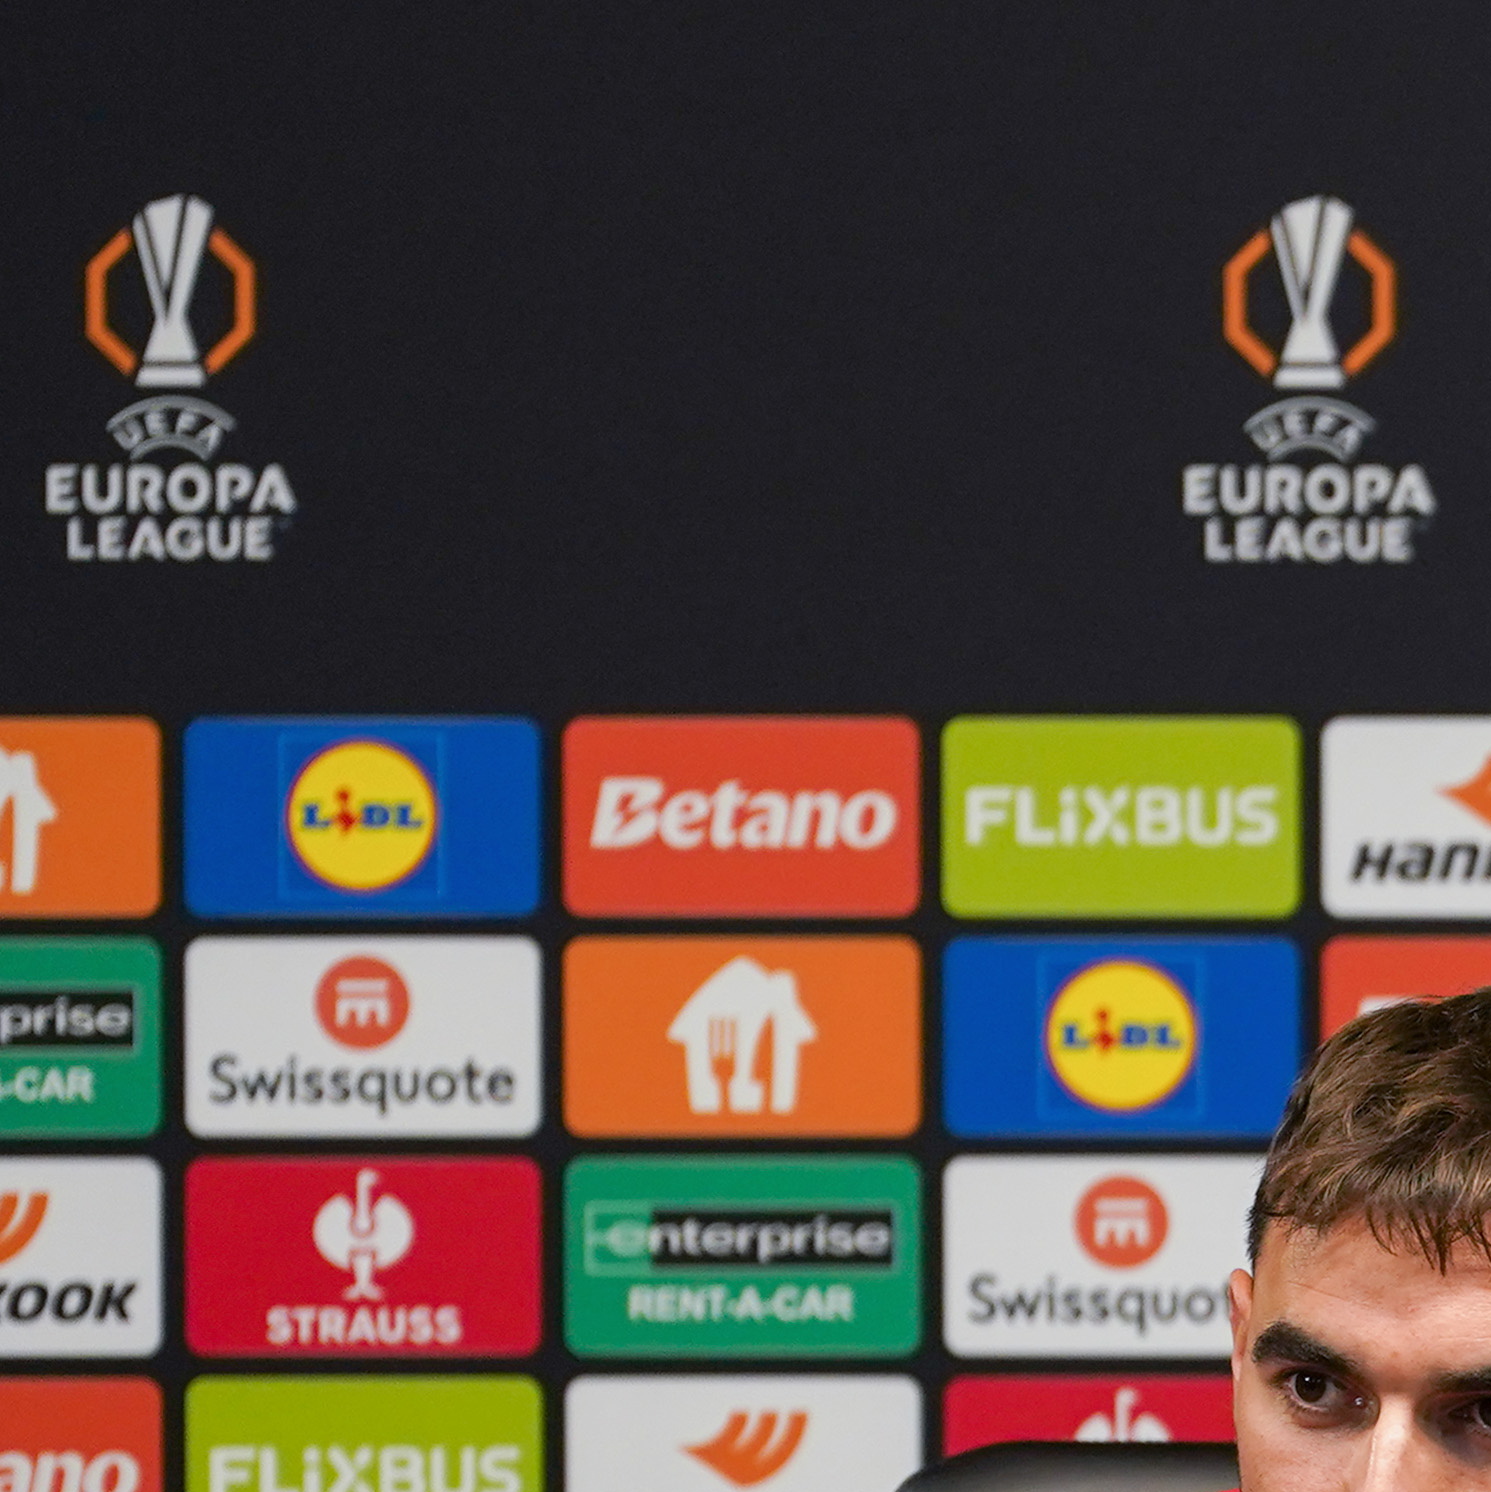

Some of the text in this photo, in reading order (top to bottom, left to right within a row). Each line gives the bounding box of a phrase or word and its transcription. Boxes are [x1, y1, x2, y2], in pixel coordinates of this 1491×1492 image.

[46, 463, 297, 514] EUROPA
[1183, 464, 1436, 516] EUROPA
[66, 515, 273, 562] LEAGUE
[1204, 516, 1413, 563] LEAGUE
[591, 776, 898, 849] Betano
[208, 1052, 516, 1115] Swissquote
[604, 1212, 890, 1263] enterprise
[266, 1304, 462, 1345] STRAUSS
[627, 1284, 855, 1322] RENT-A-CAR
